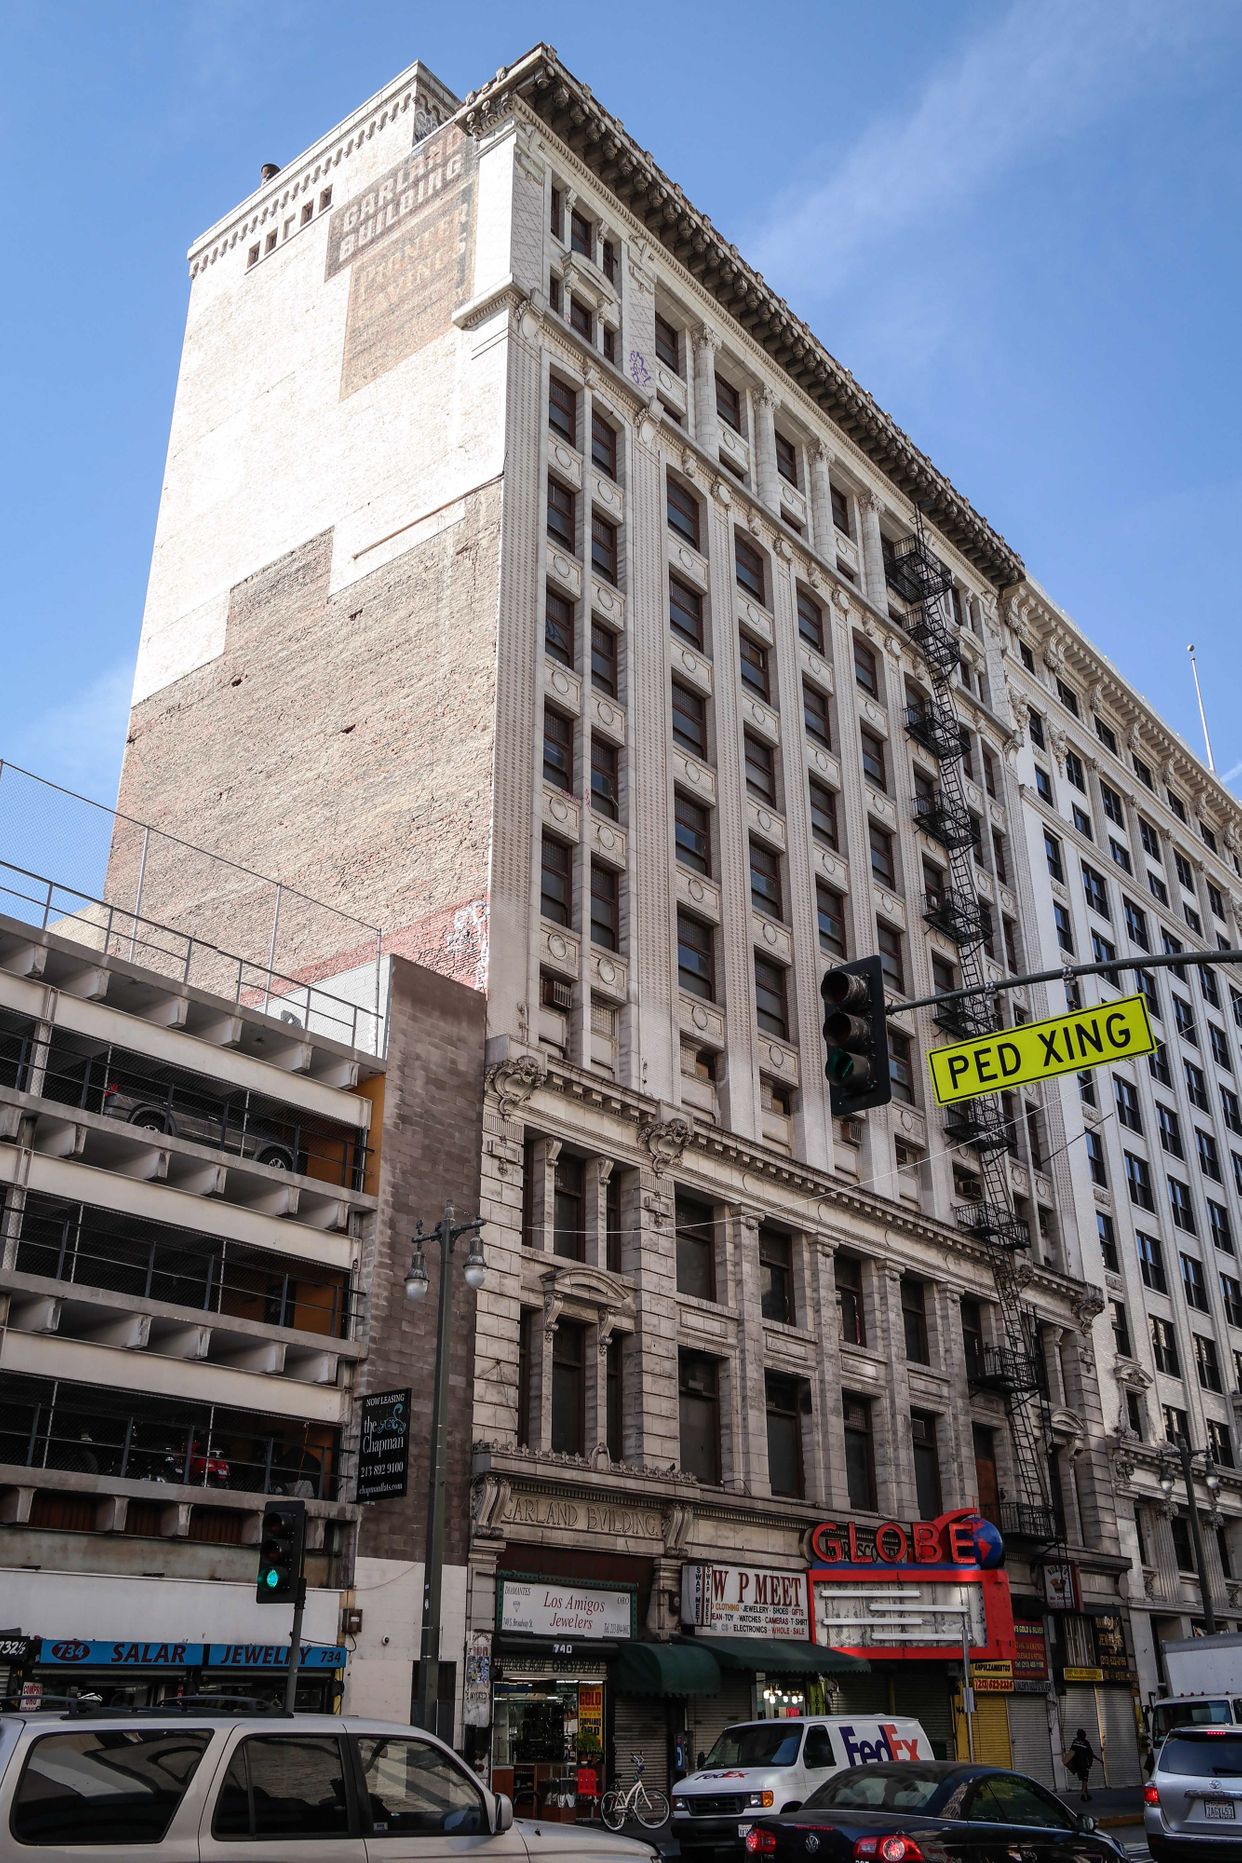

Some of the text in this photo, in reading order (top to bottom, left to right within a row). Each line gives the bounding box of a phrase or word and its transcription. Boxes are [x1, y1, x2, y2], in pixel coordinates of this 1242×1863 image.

[338, 153, 465, 262] BUILDING
[948, 1012, 1131, 1090] PED XING
[366, 1393, 405, 1407] NOW LEASING
[363, 1416, 377, 1434] the
[362, 1434, 404, 1458] Chapman
[360, 1465, 372, 1478] 213
[386, 1461, 404, 1474] 9100
[502, 1497, 577, 1527] GARLAND
[811, 1521, 977, 1564] GLOBE
[754, 1574, 801, 1607] MEET
[543, 1591, 606, 1616] Los Amigos
[715, 1603, 740, 1612] CLOTHING
[772, 1607, 788, 1615] SHOES
[549, 1612, 593, 1630] Jewelers
[733, 1624, 767, 1634] ELECTRONICS
[739, 1615, 761, 1623] WATCHES
[765, 1617, 789, 1625] CAMERAS
[56, 1643, 84, 1658] 734
[111, 1643, 187, 1664] SALAR
[320, 1650, 342, 1663] 734
[553, 1643, 572, 1654] 740
[838, 1723, 921, 1768] FedEx
[695, 1770, 750, 1781] FedEx
